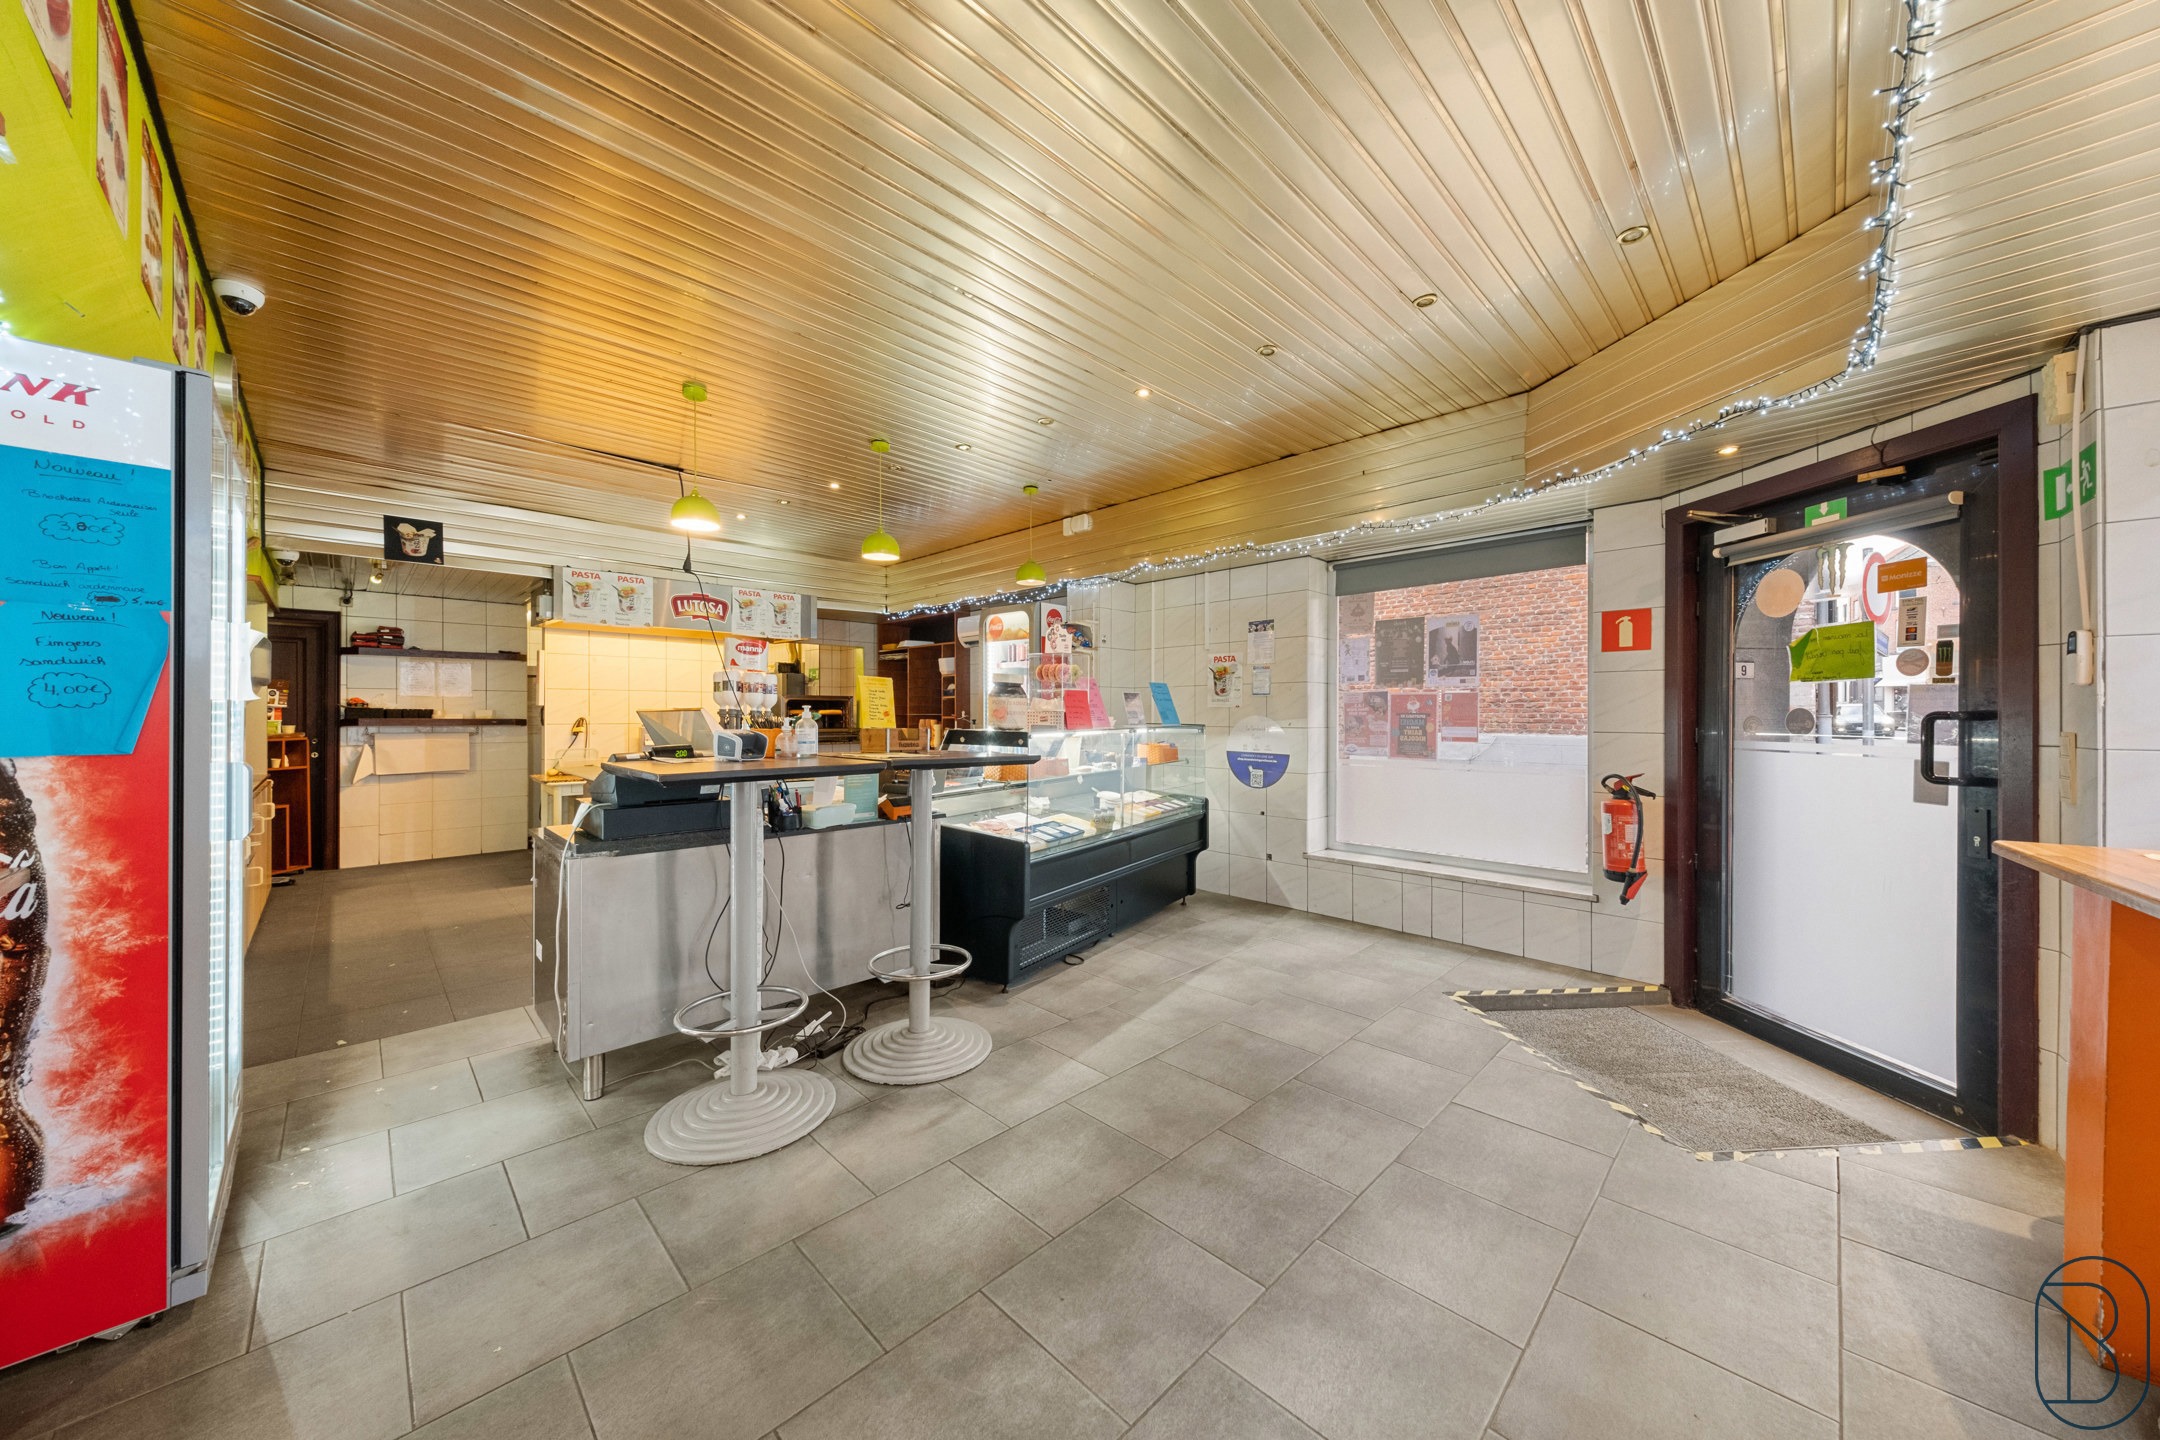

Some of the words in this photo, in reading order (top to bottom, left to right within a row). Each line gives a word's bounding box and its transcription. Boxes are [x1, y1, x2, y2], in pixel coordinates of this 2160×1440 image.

[34, 459, 121, 481] Nouveau
[571, 570, 602, 580] PASTA
[617, 575, 645, 585] PASTA
[1889, 570, 1922, 581] Monizze
[738, 589, 761, 598] PASTA
[773, 593, 795, 601] PASTA
[677, 600, 724, 617] LUTOSA
[41, 610, 106, 622] Nouveau
[35, 636, 102, 652] Fingers
[737, 643, 763, 654] manna
[1213, 655, 1237, 664] PASTA
[1741, 665, 1747, 676] 9
